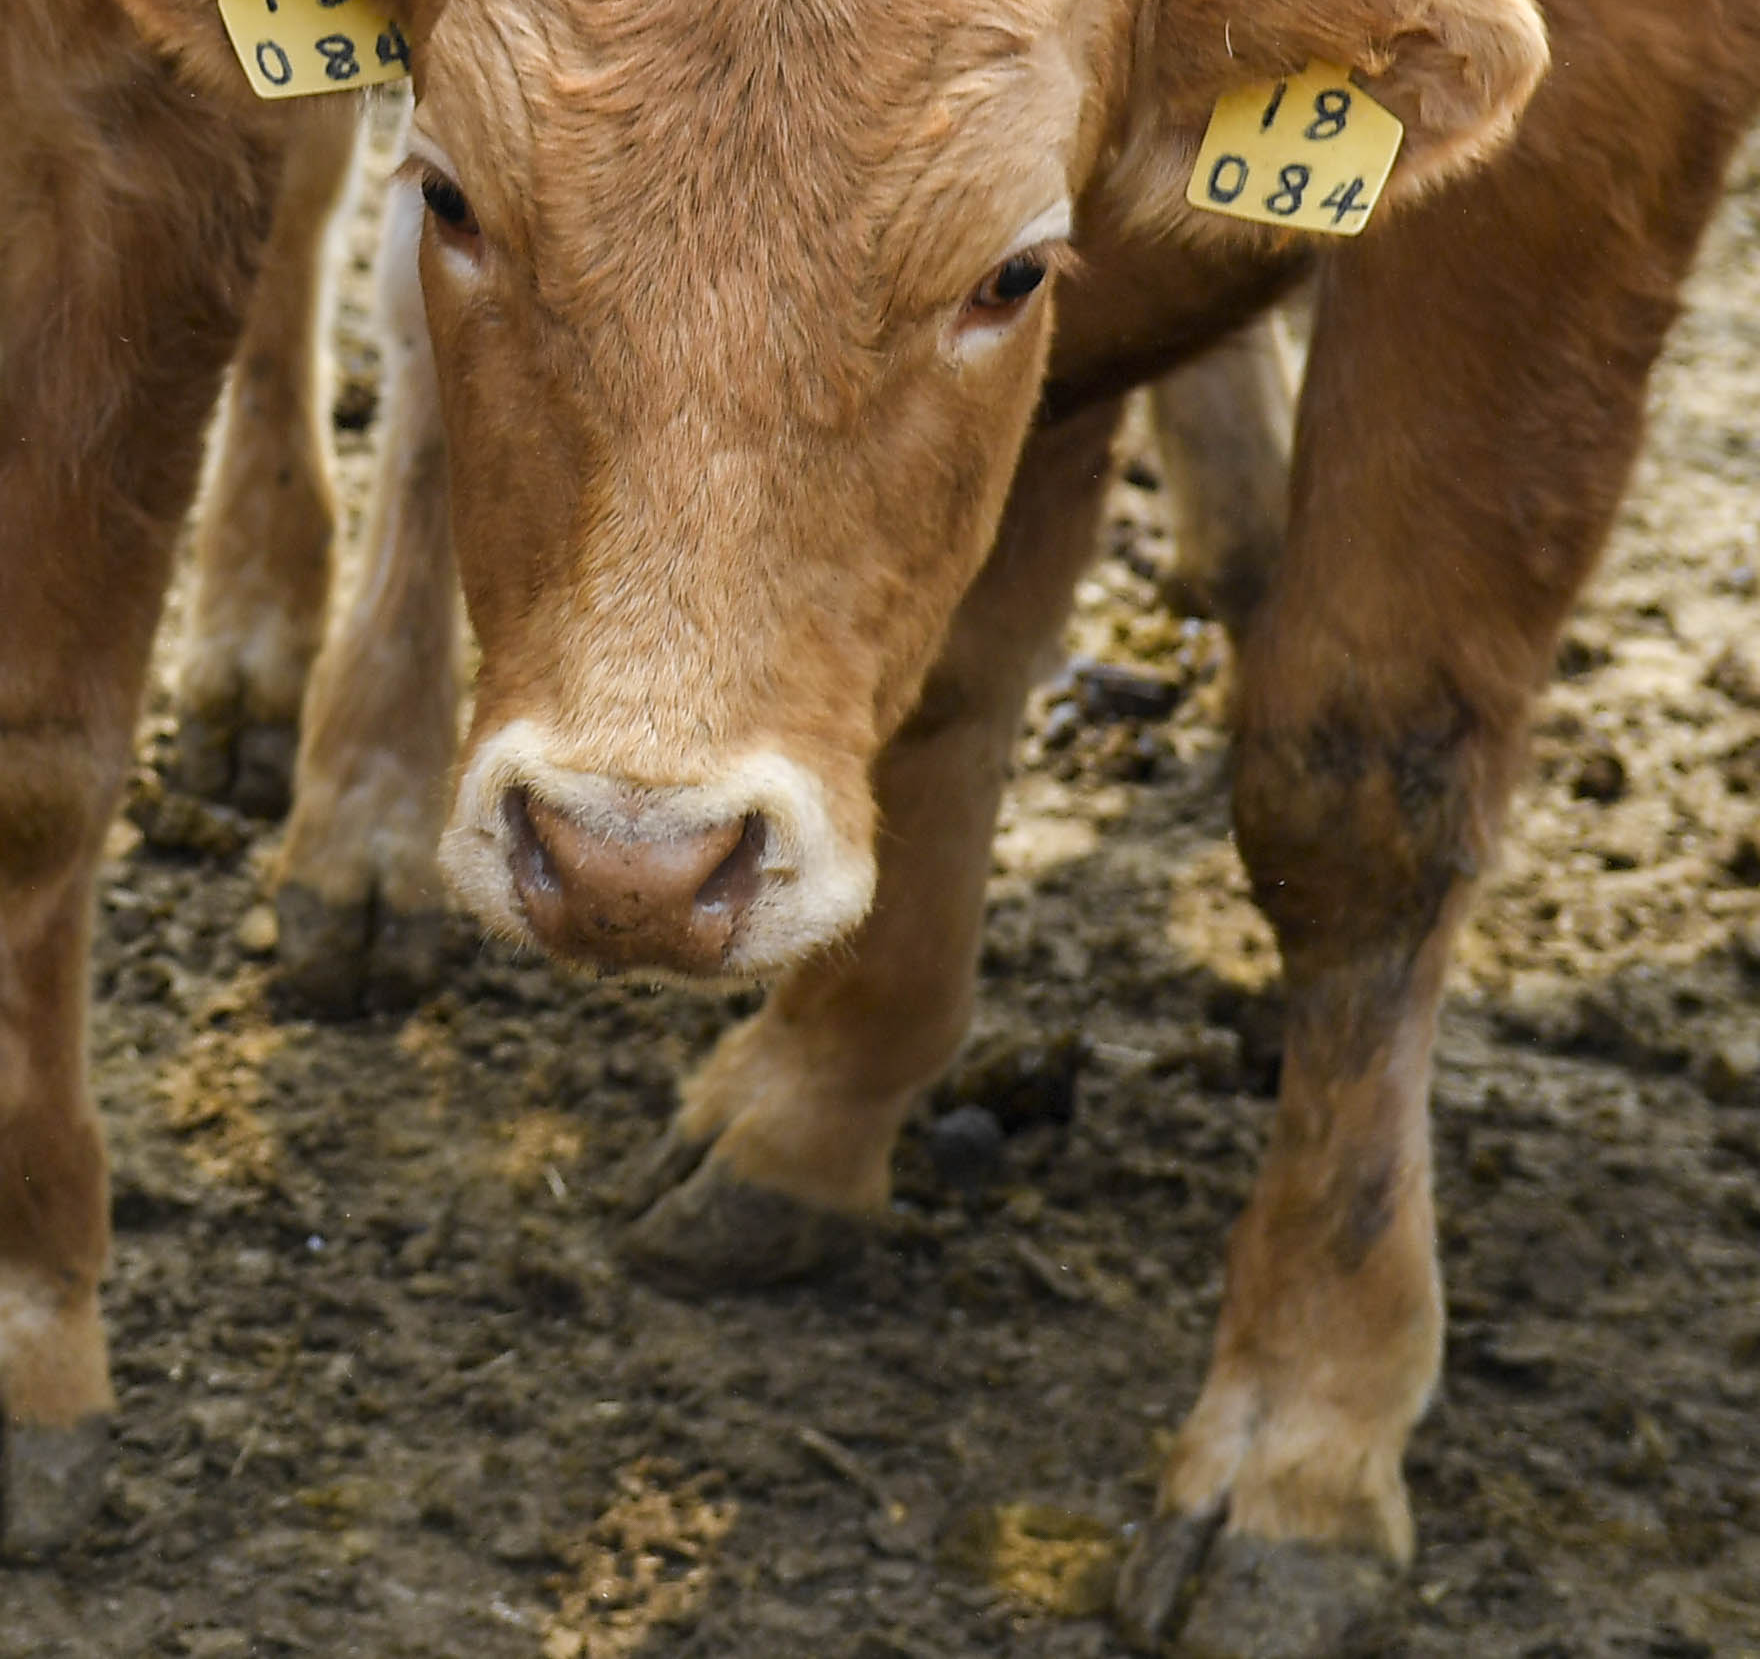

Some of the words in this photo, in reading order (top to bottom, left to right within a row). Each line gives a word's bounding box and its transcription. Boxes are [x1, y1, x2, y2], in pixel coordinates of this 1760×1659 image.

[256, 19, 412, 85] 084
[1260, 82, 1352, 140] 18
[1208, 153, 1368, 224] 084
